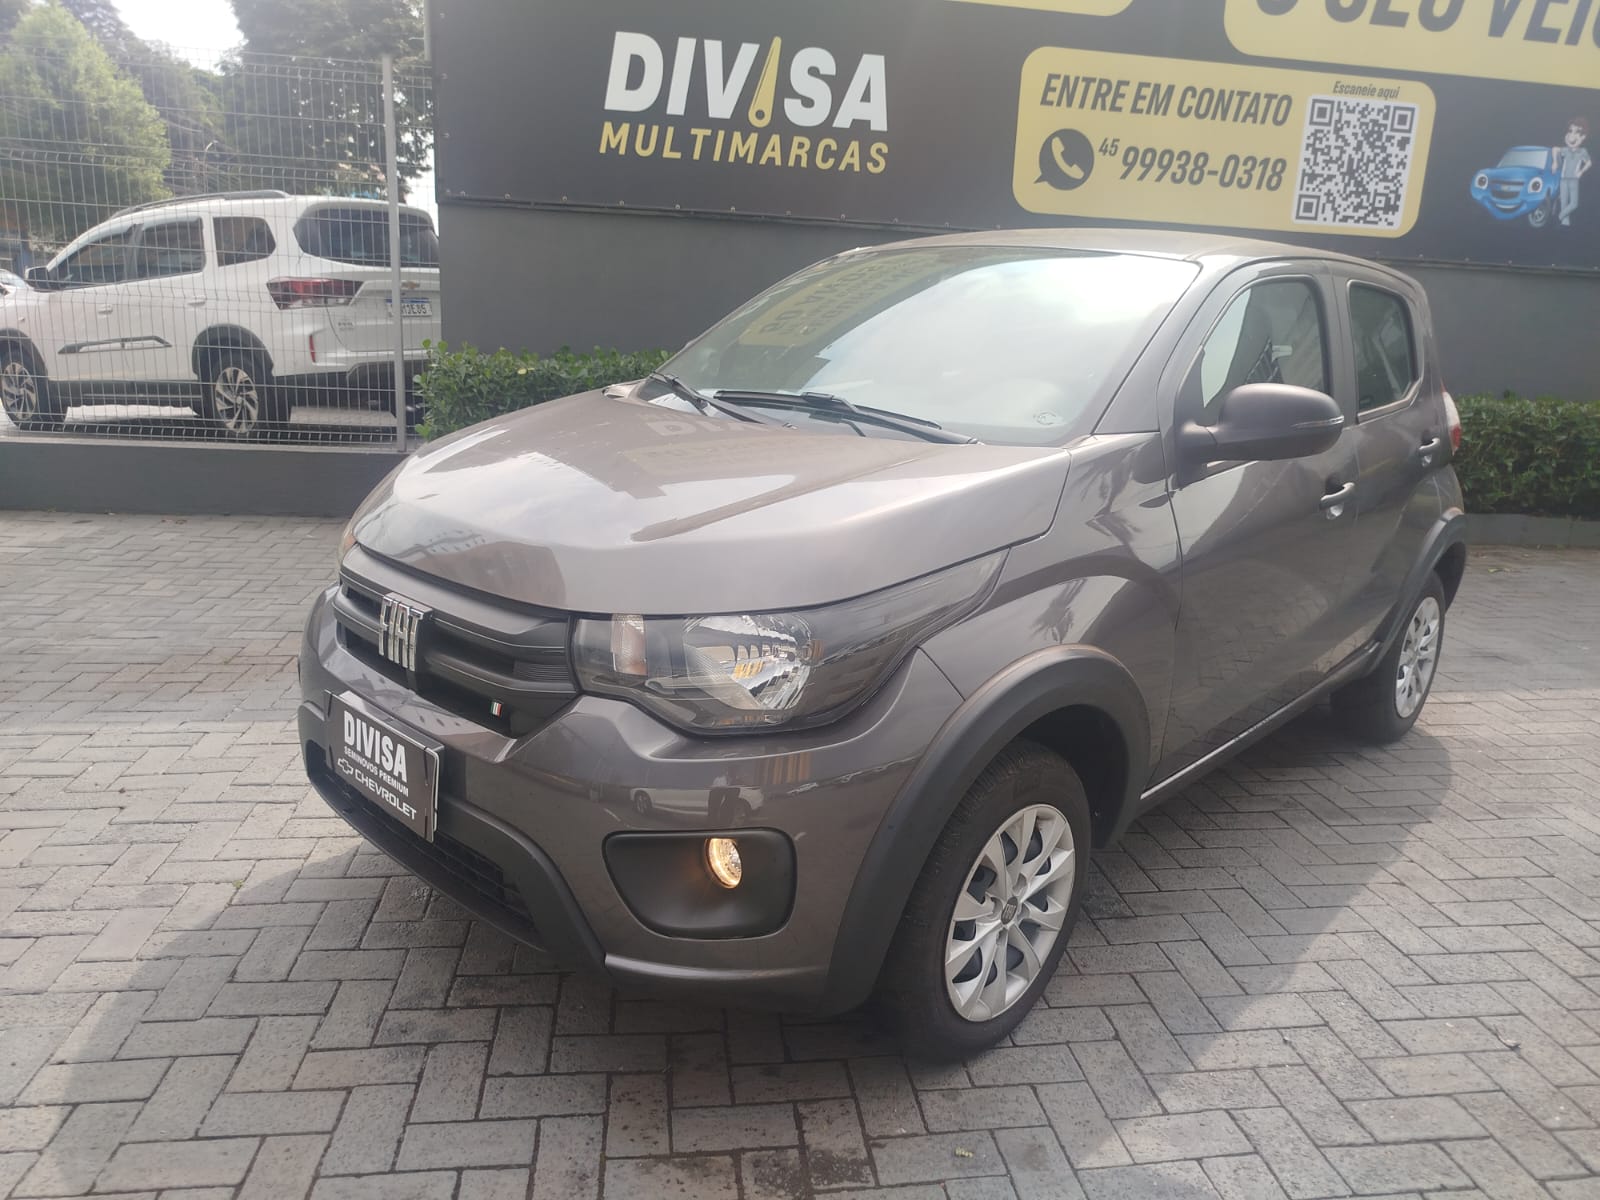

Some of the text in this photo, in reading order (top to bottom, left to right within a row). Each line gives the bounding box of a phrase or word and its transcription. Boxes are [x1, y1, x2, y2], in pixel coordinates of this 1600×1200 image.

[604, 31, 888, 131] DIVISA
[1040, 73, 1293, 127] ENTRE EM CONTATO
[1332, 80, 1400, 100] Escaneie aqui
[599, 121, 889, 174] MULTIMARCAS
[1098, 137, 1287, 192] 45 99938-0318
[378, 597, 424, 672] FIAT
[344, 710, 408, 783] DIVISA
[344, 745, 409, 797] SEMINOVOS PREMIUM
[355, 768, 417, 820] CHEVROLET
